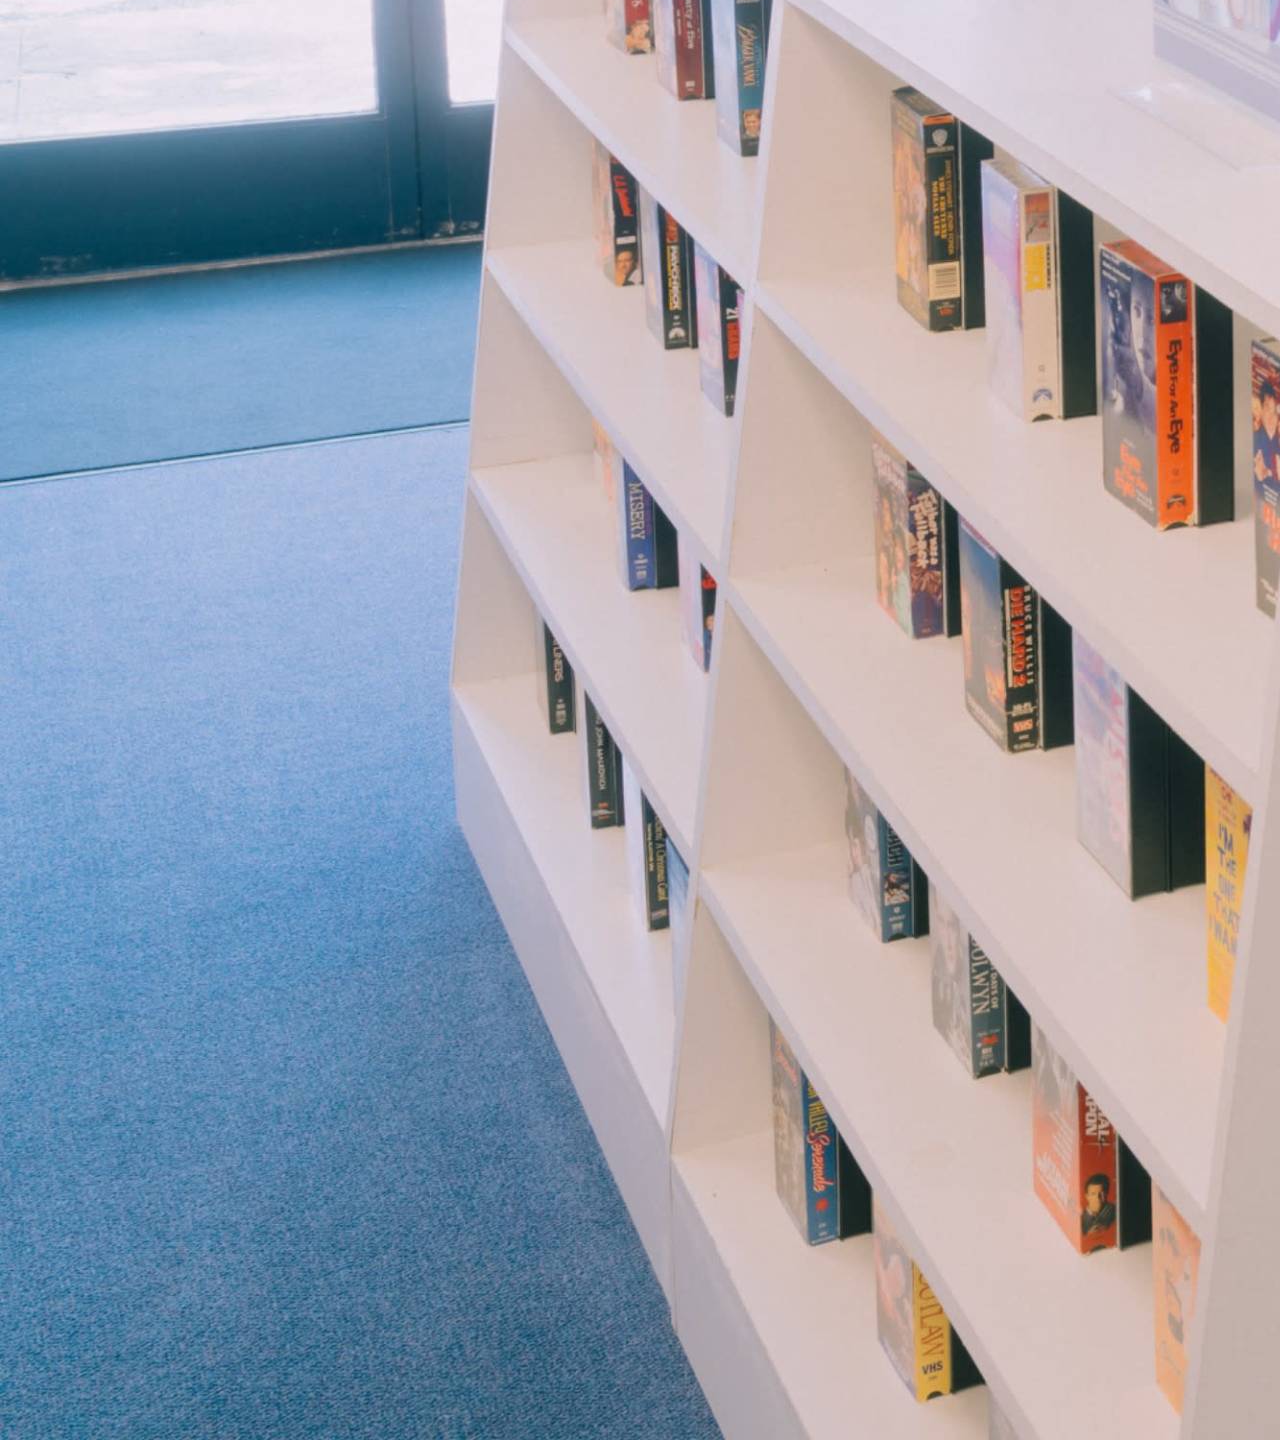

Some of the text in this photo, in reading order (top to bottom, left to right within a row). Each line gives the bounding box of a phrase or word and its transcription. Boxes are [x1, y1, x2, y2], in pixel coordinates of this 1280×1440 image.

[1166, 339, 1187, 454] Eye For An Eye
[629, 482, 647, 540] MISERY
[1010, 587, 1026, 612] DIE
[1010, 617, 1027, 669] HARD
[1023, 585, 1036, 683] BRUCE WILLIS
[921, 1361, 943, 1376] VHS
